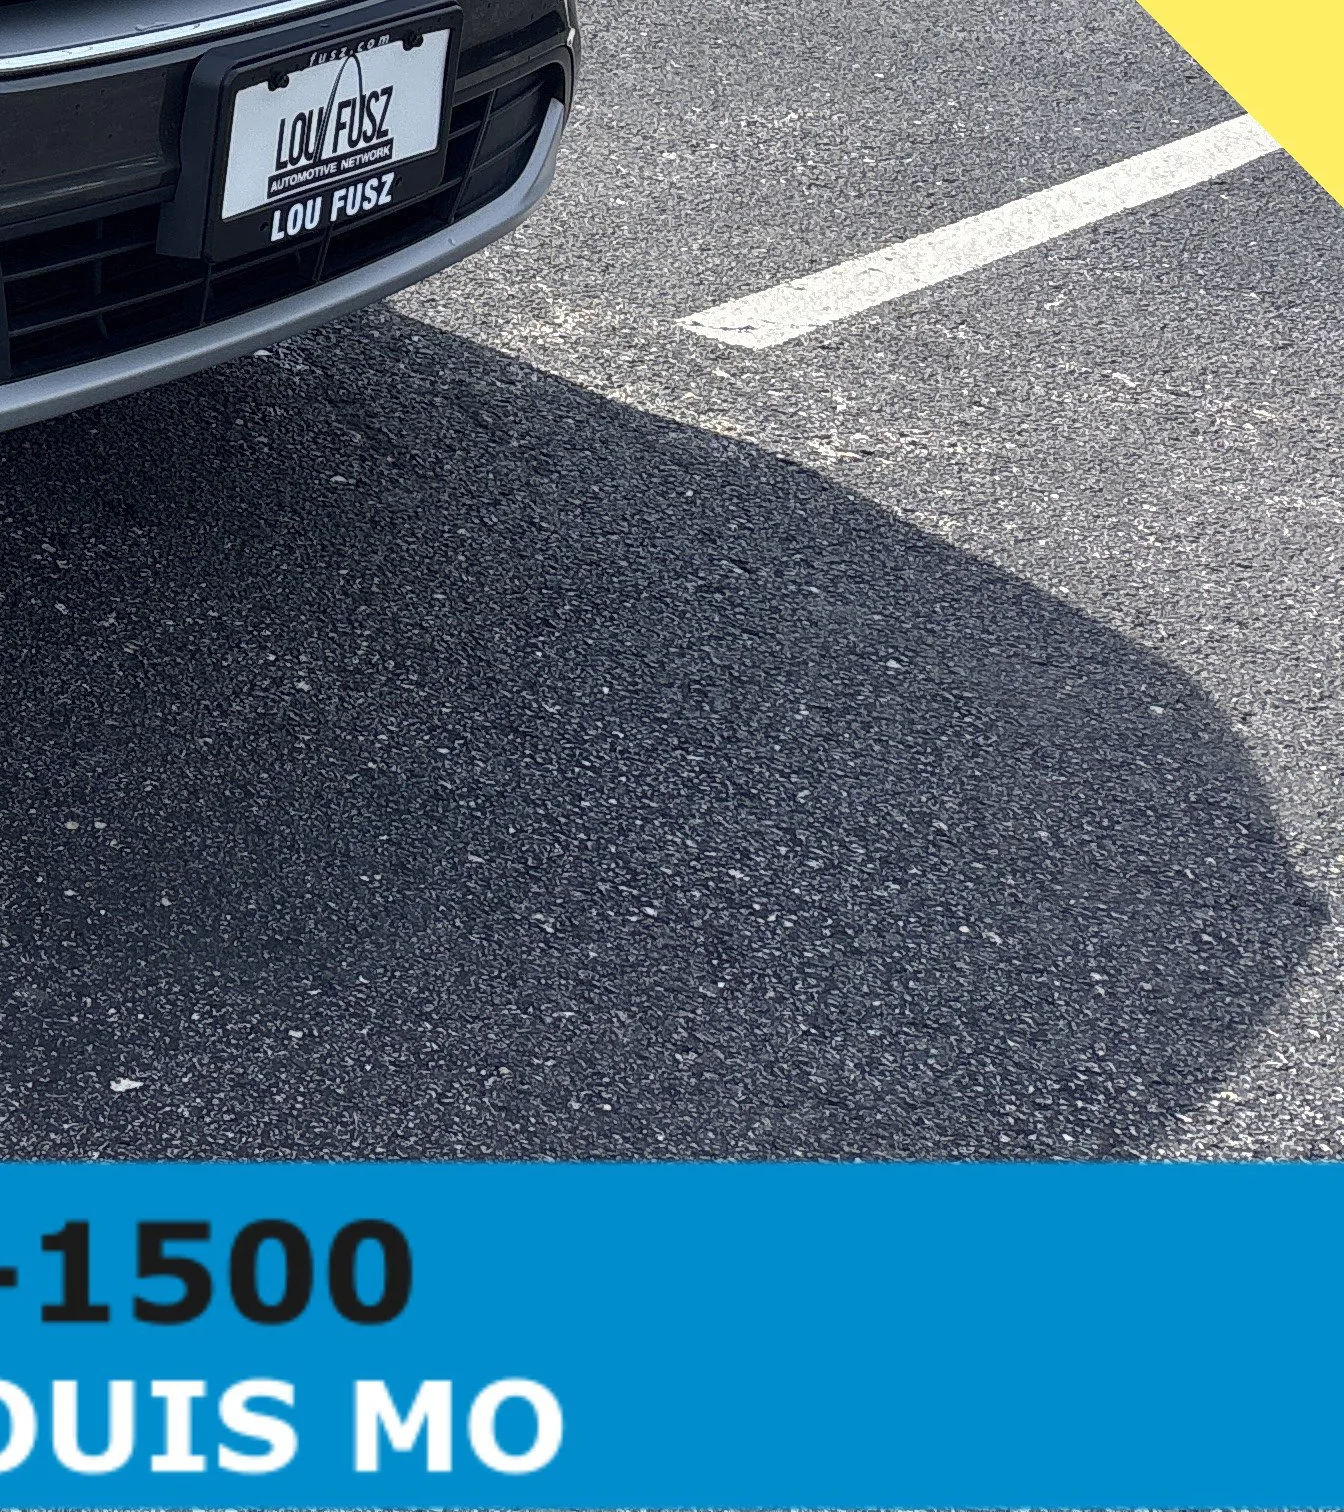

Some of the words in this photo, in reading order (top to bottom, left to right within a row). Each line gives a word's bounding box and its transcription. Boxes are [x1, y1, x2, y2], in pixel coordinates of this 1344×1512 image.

[309, 34, 390, 67] fusz.com
[275, 105, 325, 173] LOU
[331, 84, 394, 155] FUSZ
[270, 161, 338, 194] AUTOMOTIVE
[340, 144, 391, 170] NETWORK
[270, 195, 322, 243] LOU
[330, 172, 395, 223] FUSZ
